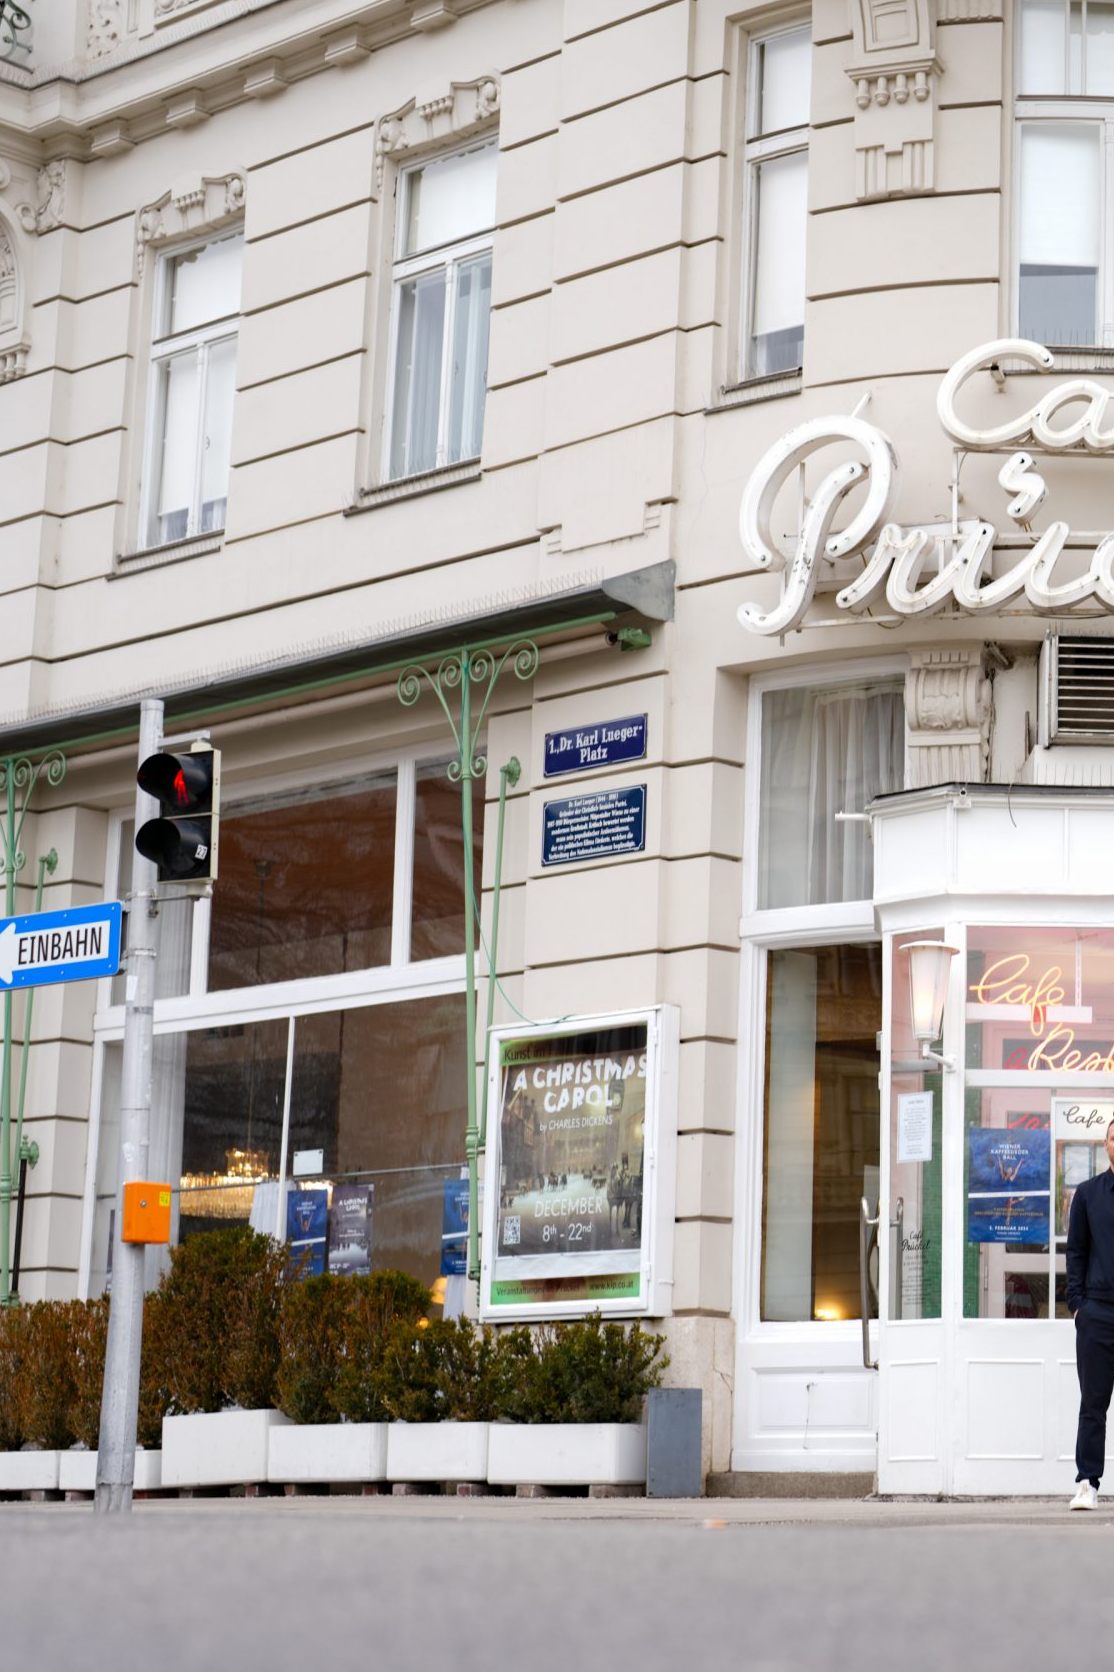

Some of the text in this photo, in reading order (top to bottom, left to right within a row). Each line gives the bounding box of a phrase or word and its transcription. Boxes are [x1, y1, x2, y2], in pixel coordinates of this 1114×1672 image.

[575, 729, 598, 749] Karl
[580, 745, 608, 763] Platz
[18, 926, 103, 966] EINBAHN
[969, 953, 1065, 1036] Cafe
[504, 1047, 531, 1061] Kunst
[513, 1053, 647, 1091] A CHRISTMAS
[544, 1084, 613, 1113] CAROL
[540, 1115, 613, 1131] by CHARLES DICKENS
[1063, 1106, 1106, 1128] Cafe
[534, 1196, 602, 1218] DECEMBER
[542, 1224, 557, 1242] 8th
[568, 1221, 592, 1241] 22nd
